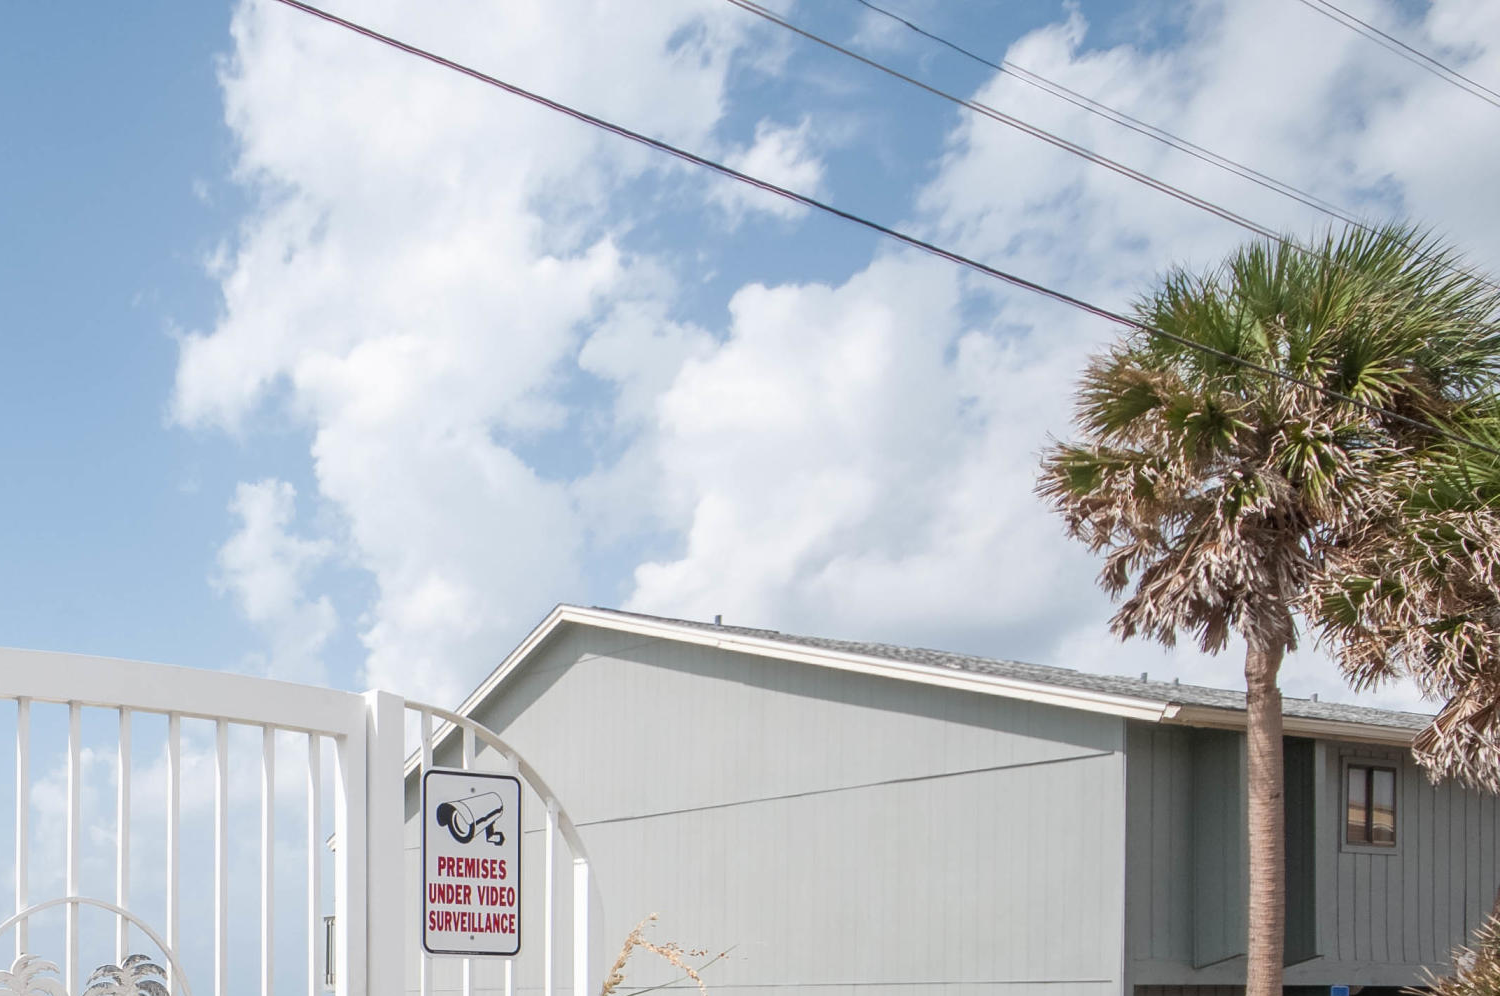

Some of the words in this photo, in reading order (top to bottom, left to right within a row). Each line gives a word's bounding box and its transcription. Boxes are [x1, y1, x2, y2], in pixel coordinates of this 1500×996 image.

[437, 856, 507, 880] PREMISES
[428, 883, 471, 905] UNDER
[477, 885, 515, 907] VIDEO
[428, 910, 516, 934] SURVEILLANCE
